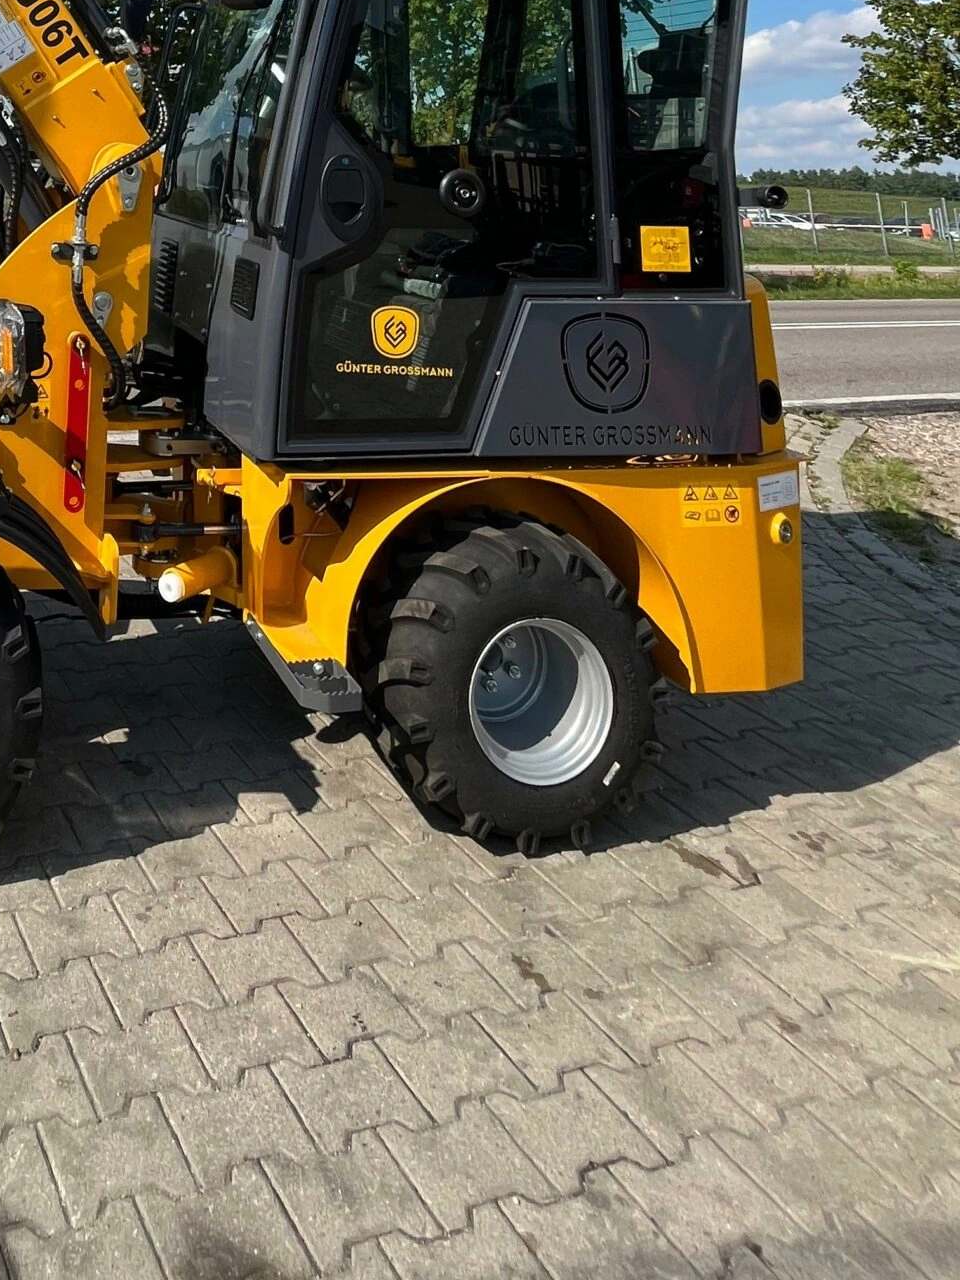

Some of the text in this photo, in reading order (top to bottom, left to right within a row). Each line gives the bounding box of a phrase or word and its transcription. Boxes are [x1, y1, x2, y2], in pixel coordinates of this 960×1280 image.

[335, 361, 453, 377] GÜNTER GROSSMANN
[509, 422, 712, 446] GÜNTER GROSSMANN
